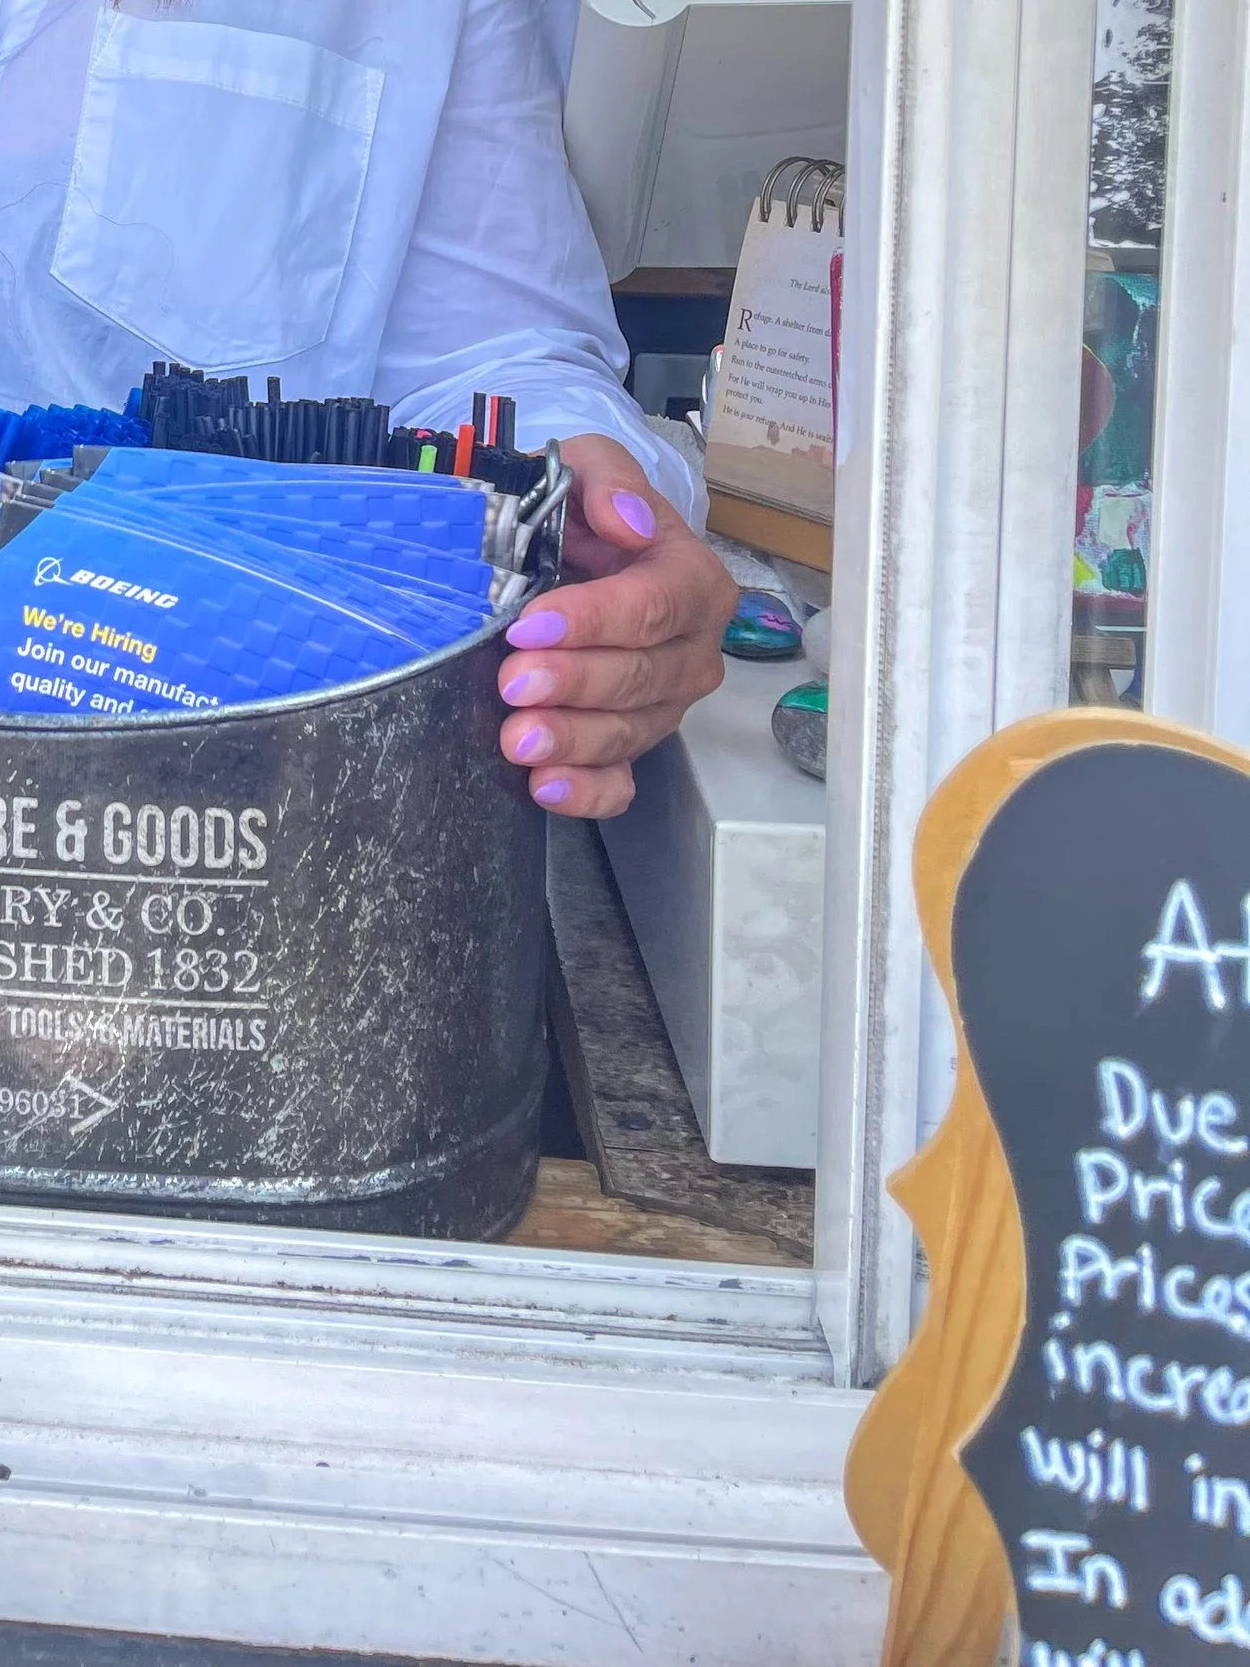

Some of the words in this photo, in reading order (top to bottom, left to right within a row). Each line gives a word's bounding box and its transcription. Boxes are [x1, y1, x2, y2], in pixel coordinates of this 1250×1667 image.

[790, 279, 803, 290] The
[803, 281, 820, 294] Lord
[774, 316, 782, 325] A
[782, 317, 805, 332] shelter
[806, 323, 823, 336] from
[734, 337, 740, 346] A
[740, 337, 759, 351] place
[759, 343, 767, 353] to
[767, 345, 777, 357] go
[728, 372, 740, 383] For
[740, 374, 751, 386] He
[751, 377, 765, 390] will
[765, 384, 784, 398] wrap
[784, 389, 797, 401] you
[798, 392, 808, 404] up
[809, 394, 817, 404] in
[730, 354, 745, 366] Run
[746, 359, 753, 368] to
[754, 360, 765, 371] the
[765, 363, 808, 383] outstretched
[809, 377, 828, 389] arms
[725, 386, 749, 402] protect
[722, 404, 733, 415] He
[733, 406, 740, 416] is
[779, 422, 796, 434] And
[796, 426, 807, 437] He
[69, 568, 180, 610] BOEING
[23, 604, 86, 638] We're
[90, 622, 158, 664] Hiring
[17, 637, 66, 665] Join
[71, 653, 110, 677] our
[11, 671, 87, 708] quality
[89, 693, 134, 715] and
[55, 799, 88, 864] &
[102, 801, 269, 872] GOODS
[85, 889, 126, 933] &
[139, 894, 227, 937] CO.
[146, 945, 262, 994] 1832
[121, 1013, 268, 1053] MATERIALS
[1094, 1055, 1249, 1156] Due
[1019, 1424, 1150, 1514] will
[1019, 1528, 1128, 1611] In
